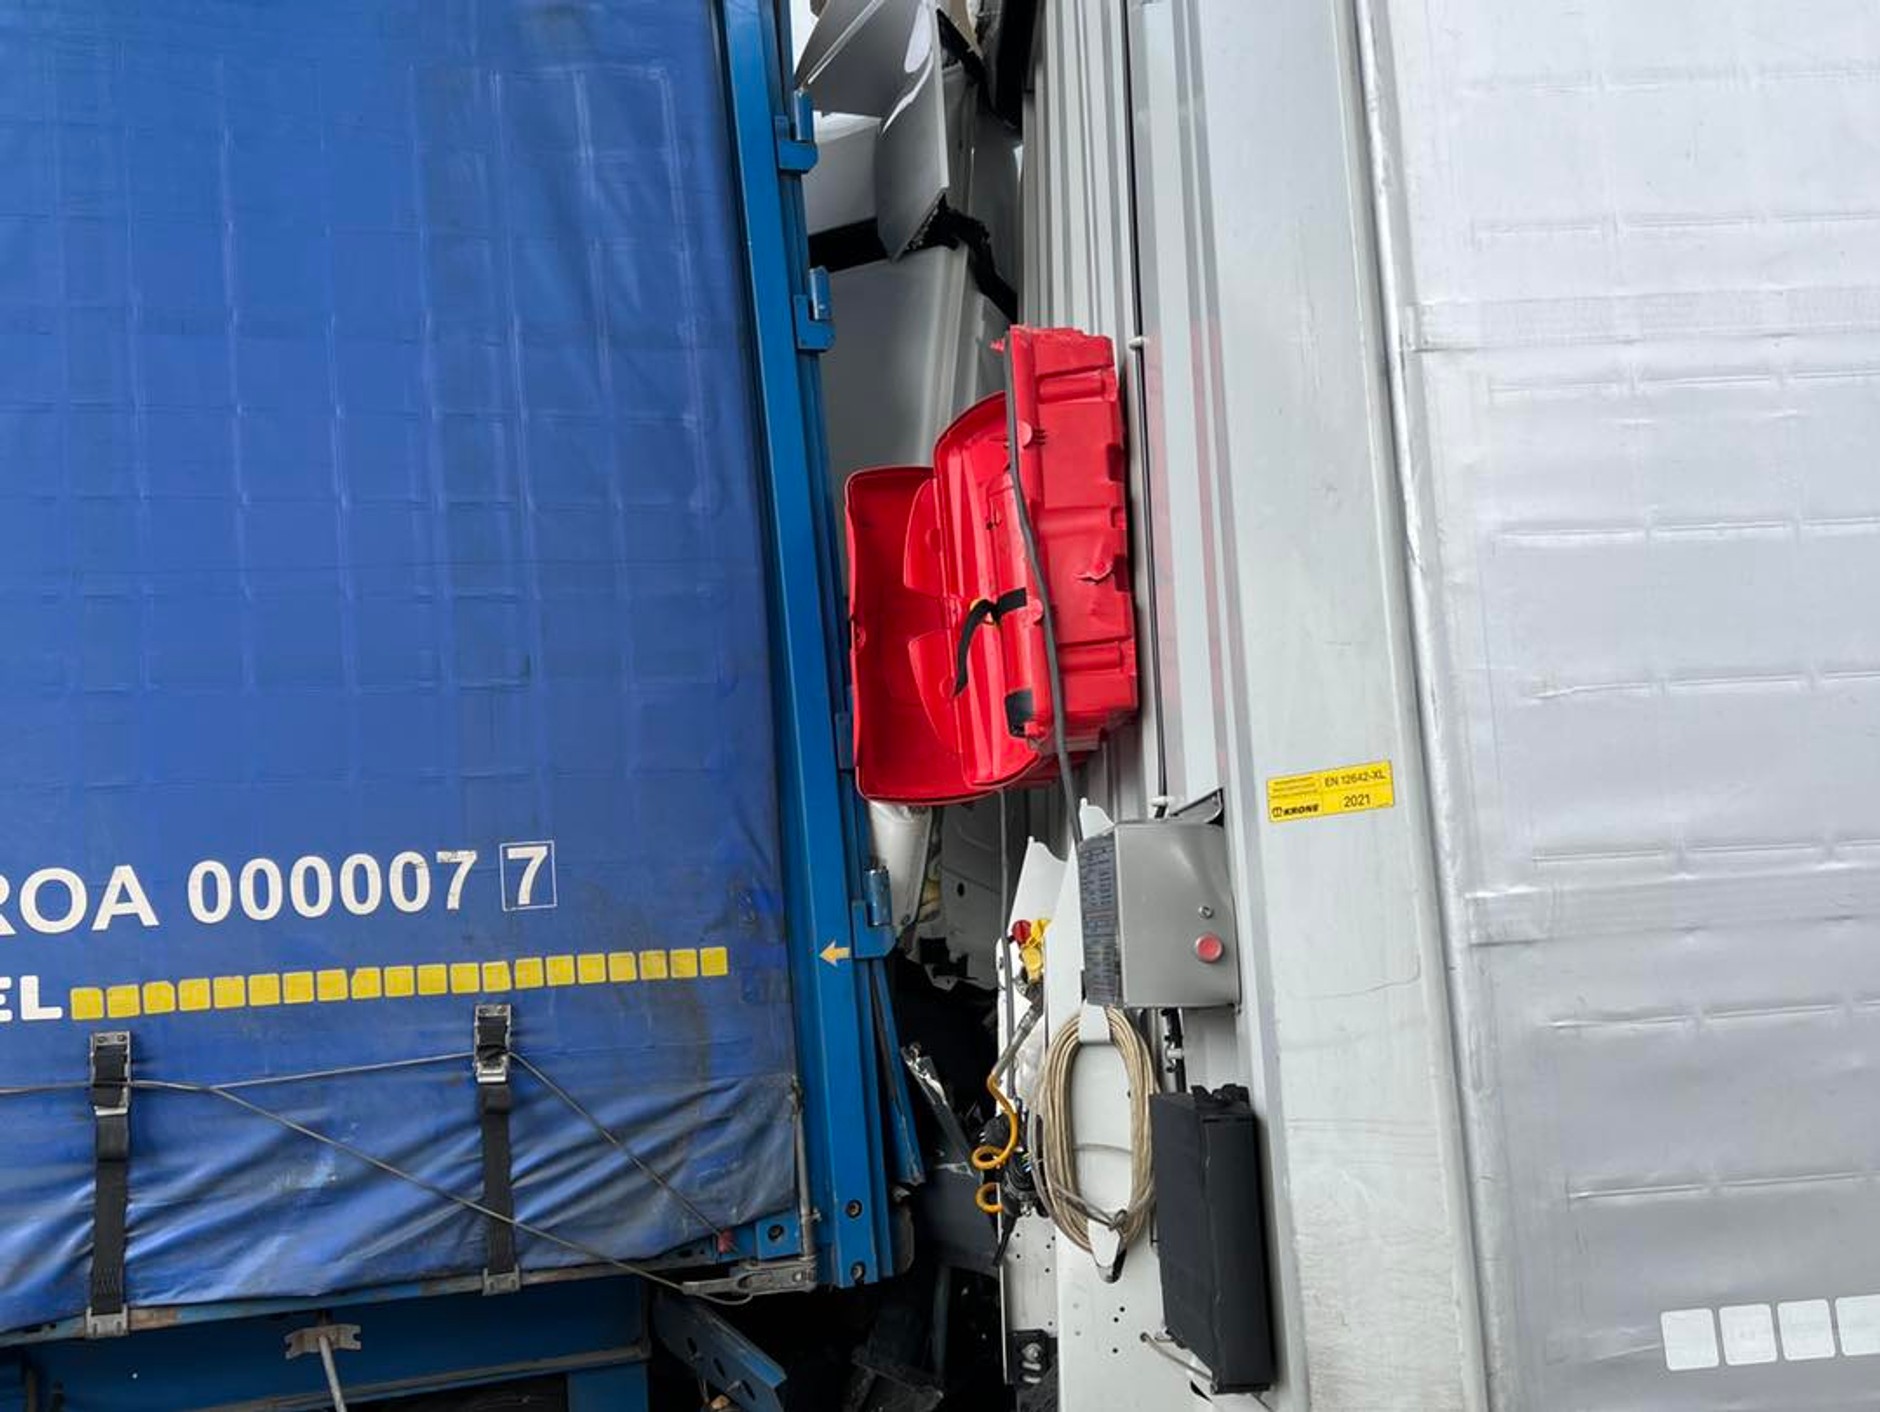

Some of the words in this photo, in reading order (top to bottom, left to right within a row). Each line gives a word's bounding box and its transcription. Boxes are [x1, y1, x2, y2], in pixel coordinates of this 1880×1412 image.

[1324, 776, 1339, 787] EN
[1343, 794, 1371, 808] 2021
[1283, 803, 1319, 816] KRONE
[187, 850, 478, 924] 000007
[506, 846, 549, 905] 7
[0, 975, 63, 1022] L
